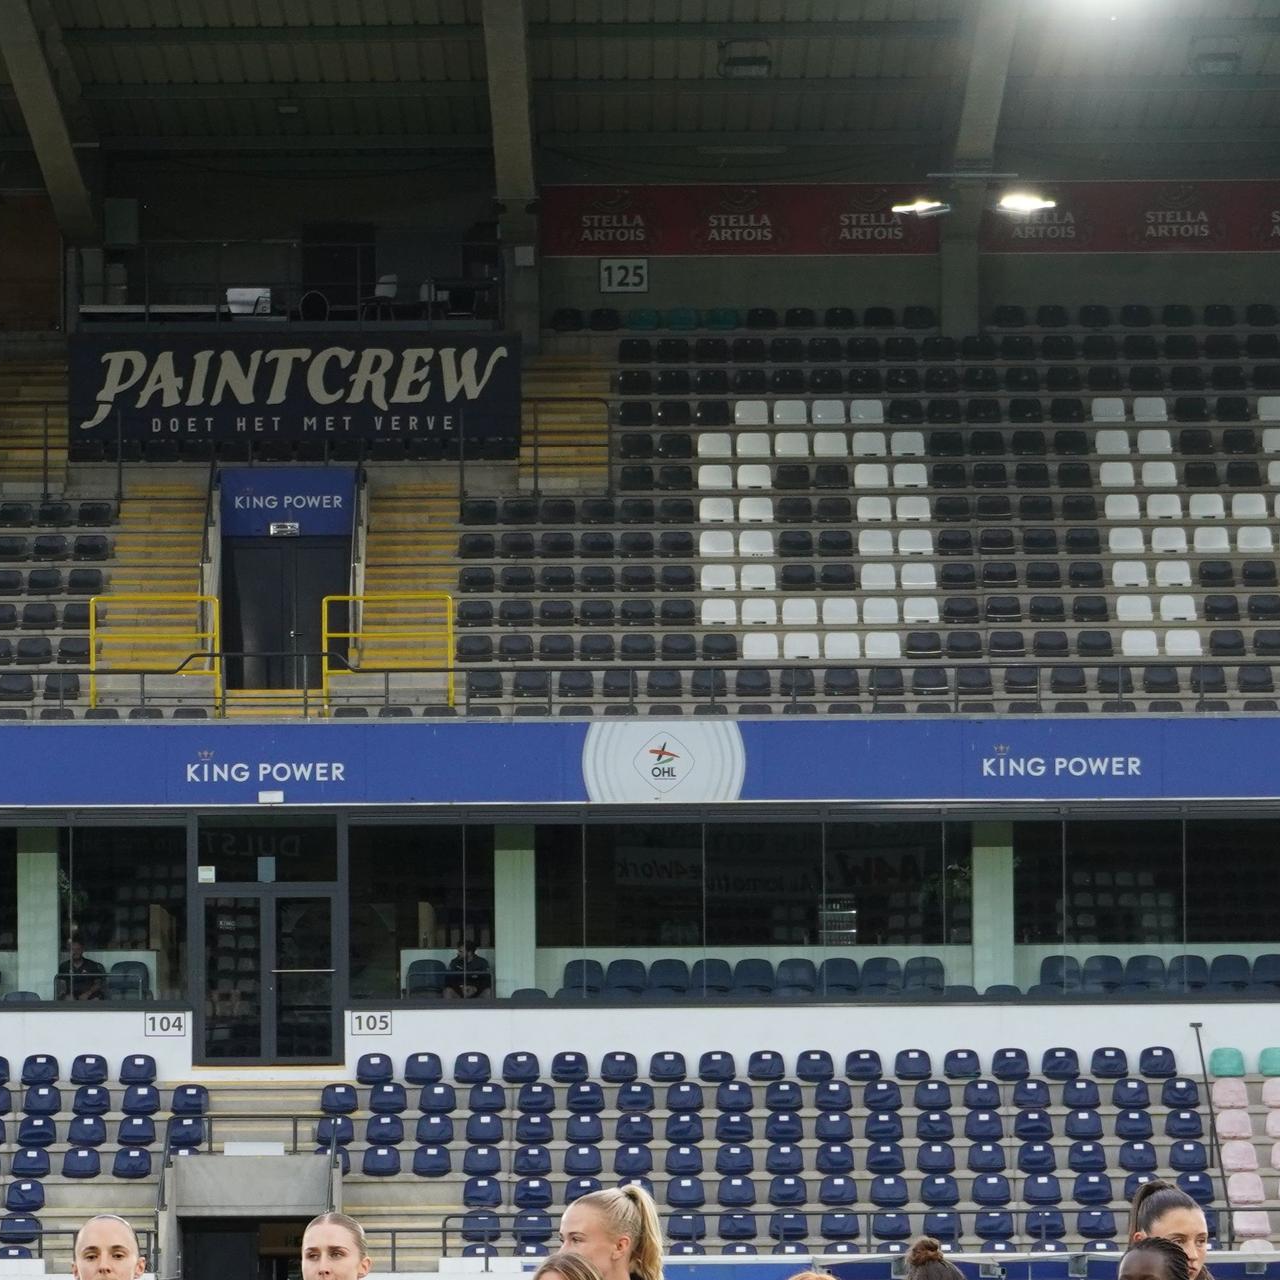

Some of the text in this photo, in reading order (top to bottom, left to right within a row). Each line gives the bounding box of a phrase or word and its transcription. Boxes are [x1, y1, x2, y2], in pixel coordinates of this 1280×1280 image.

[581, 215, 644, 228] STELLA
[709, 214, 772, 228] STELLA
[840, 213, 902, 226] STELLA
[1145, 211, 1208, 224] STELLA
[581, 228, 646, 242] ARTOIS
[708, 228, 772, 241] ARTOIS
[839, 227, 904, 240] ARTOIS
[1011, 225, 1076, 239] ARTOIS
[1145, 224, 1209, 237] ARTOIS
[603, 265, 644, 287] 125
[79, 345, 508, 430] PAINTCREW
[152, 415, 454, 433] DOET HET MET VERVE
[234, 495, 343, 509] KING POWER
[187, 763, 345, 782] KING POWER
[651, 766, 677, 778] OHL
[982, 757, 1142, 777] KING POWER
[147, 1016, 183, 1032] 104
[354, 1015, 390, 1031] 105
